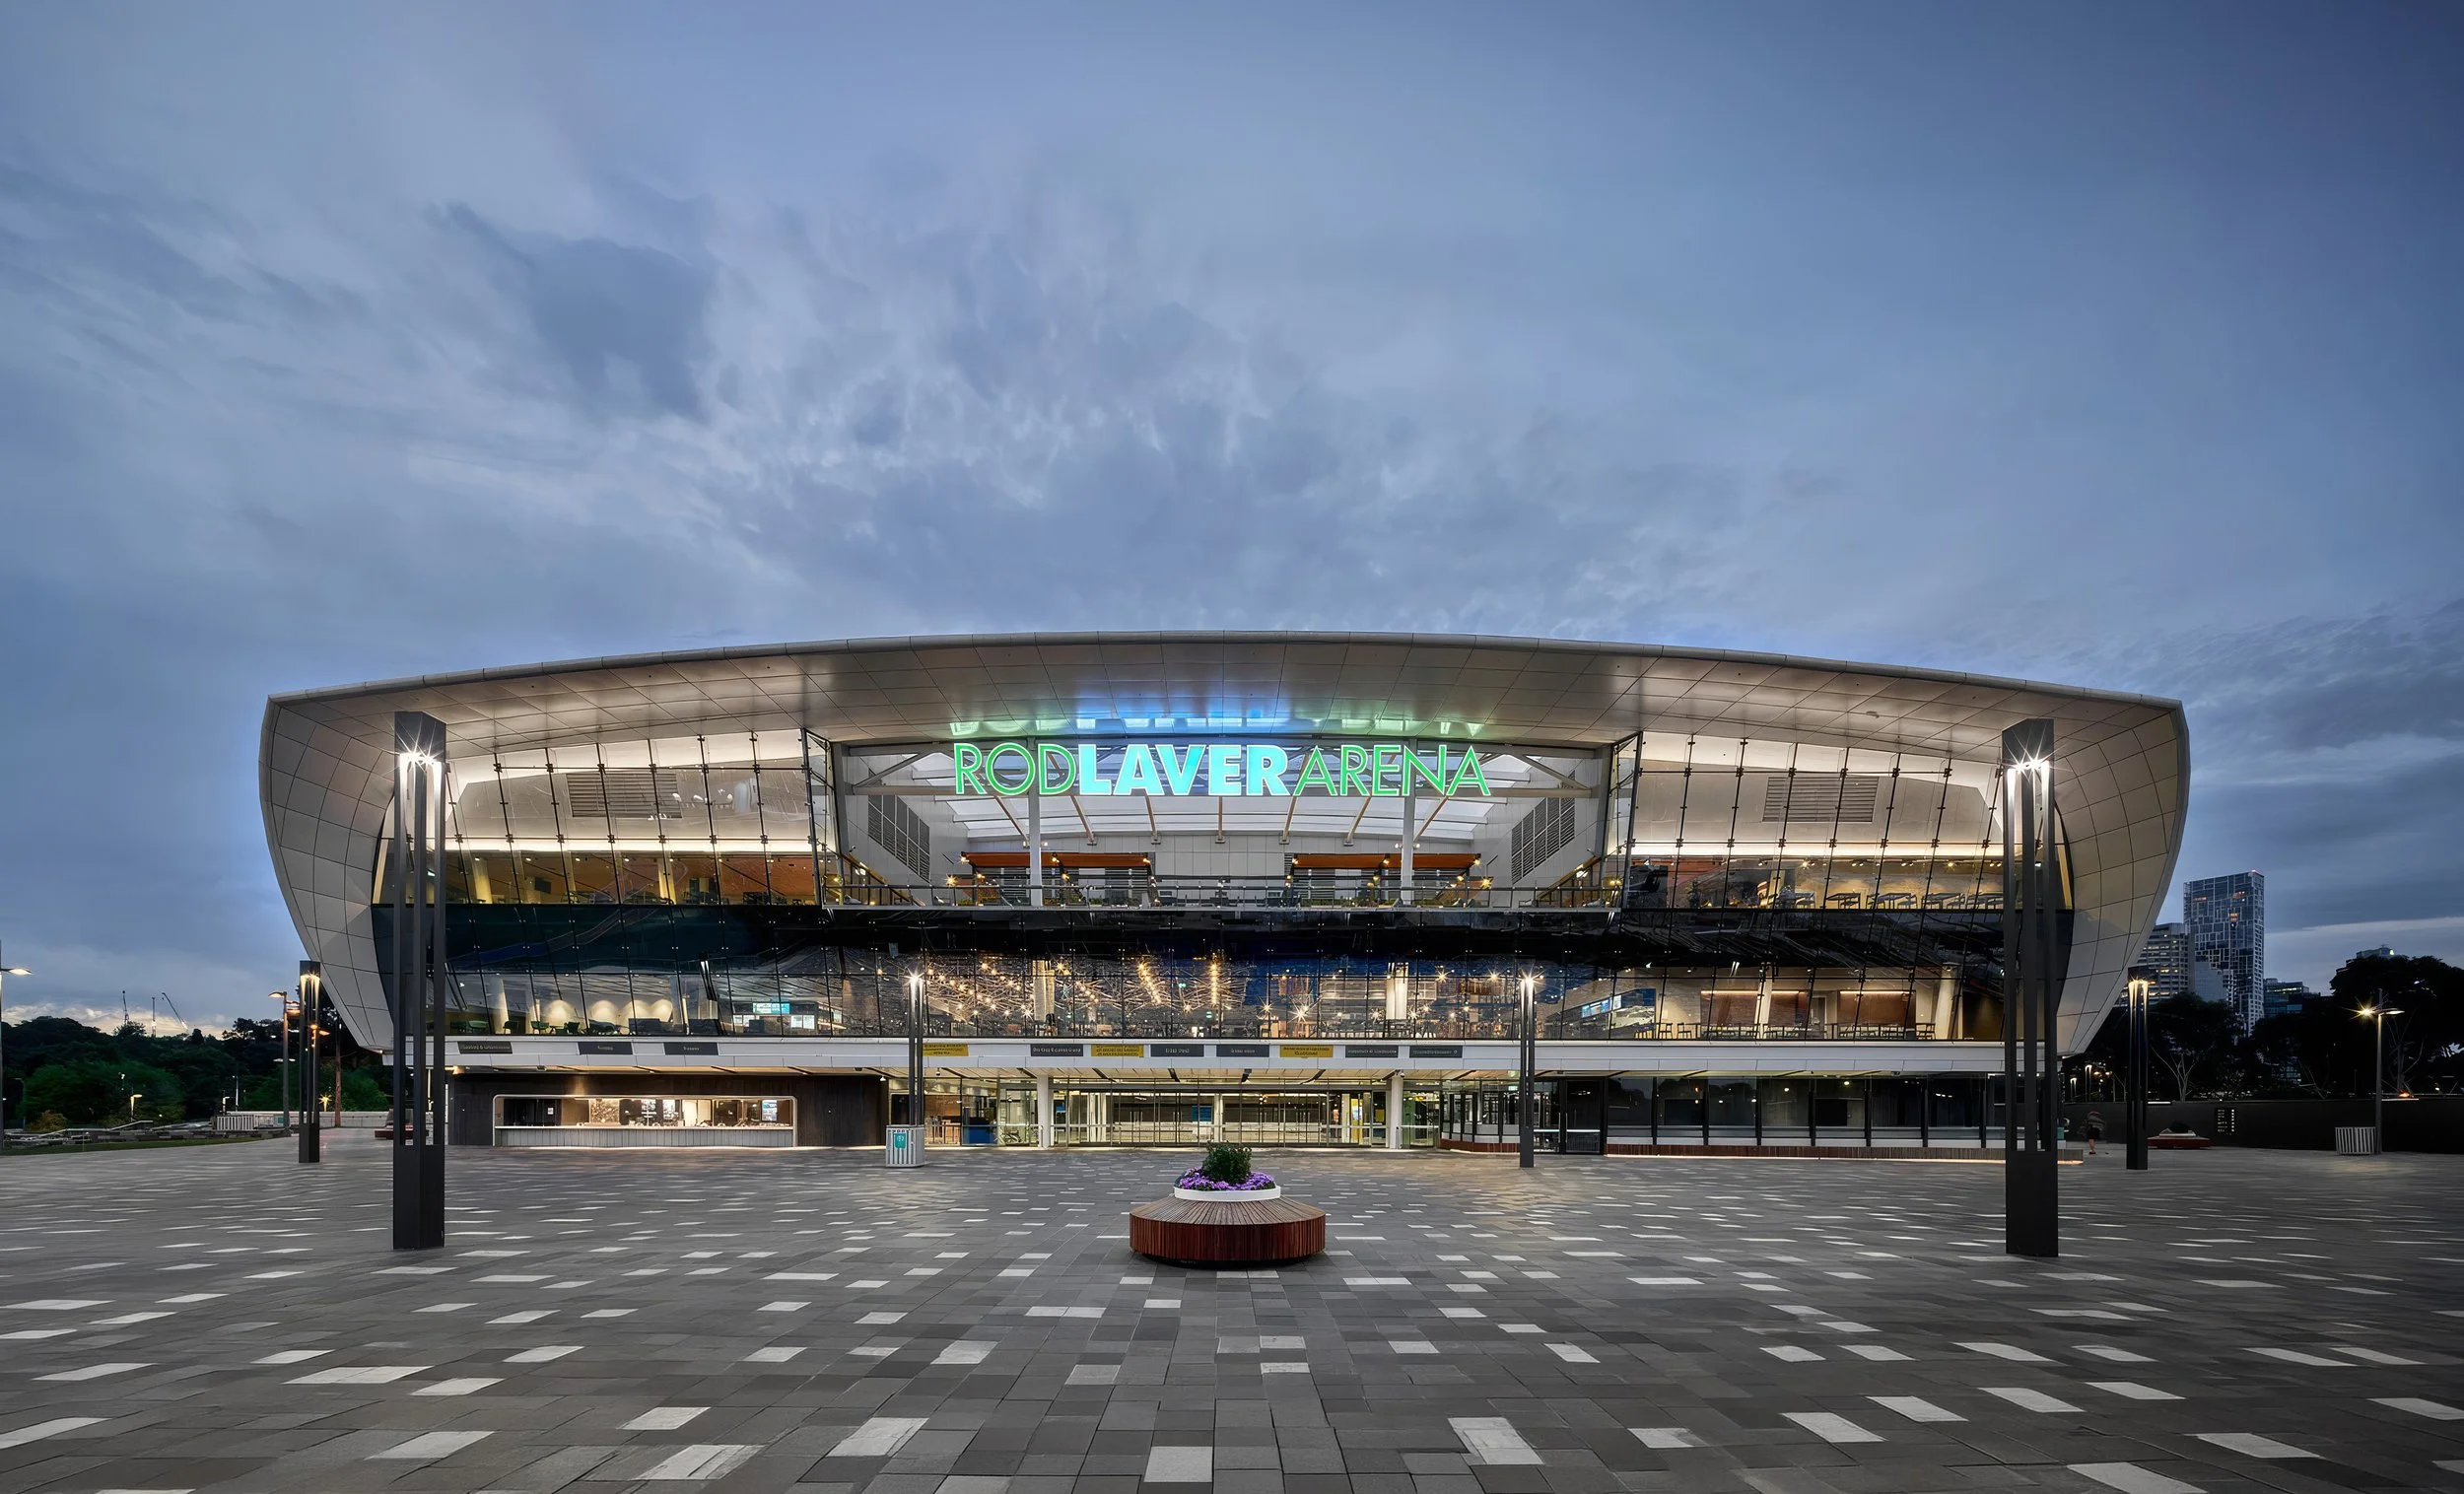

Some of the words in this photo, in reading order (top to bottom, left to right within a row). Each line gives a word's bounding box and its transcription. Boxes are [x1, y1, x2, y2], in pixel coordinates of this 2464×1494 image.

[953, 743, 1076, 795] ROD
[1078, 744, 1292, 796] LAVER
[1294, 744, 1491, 796] ARENA
